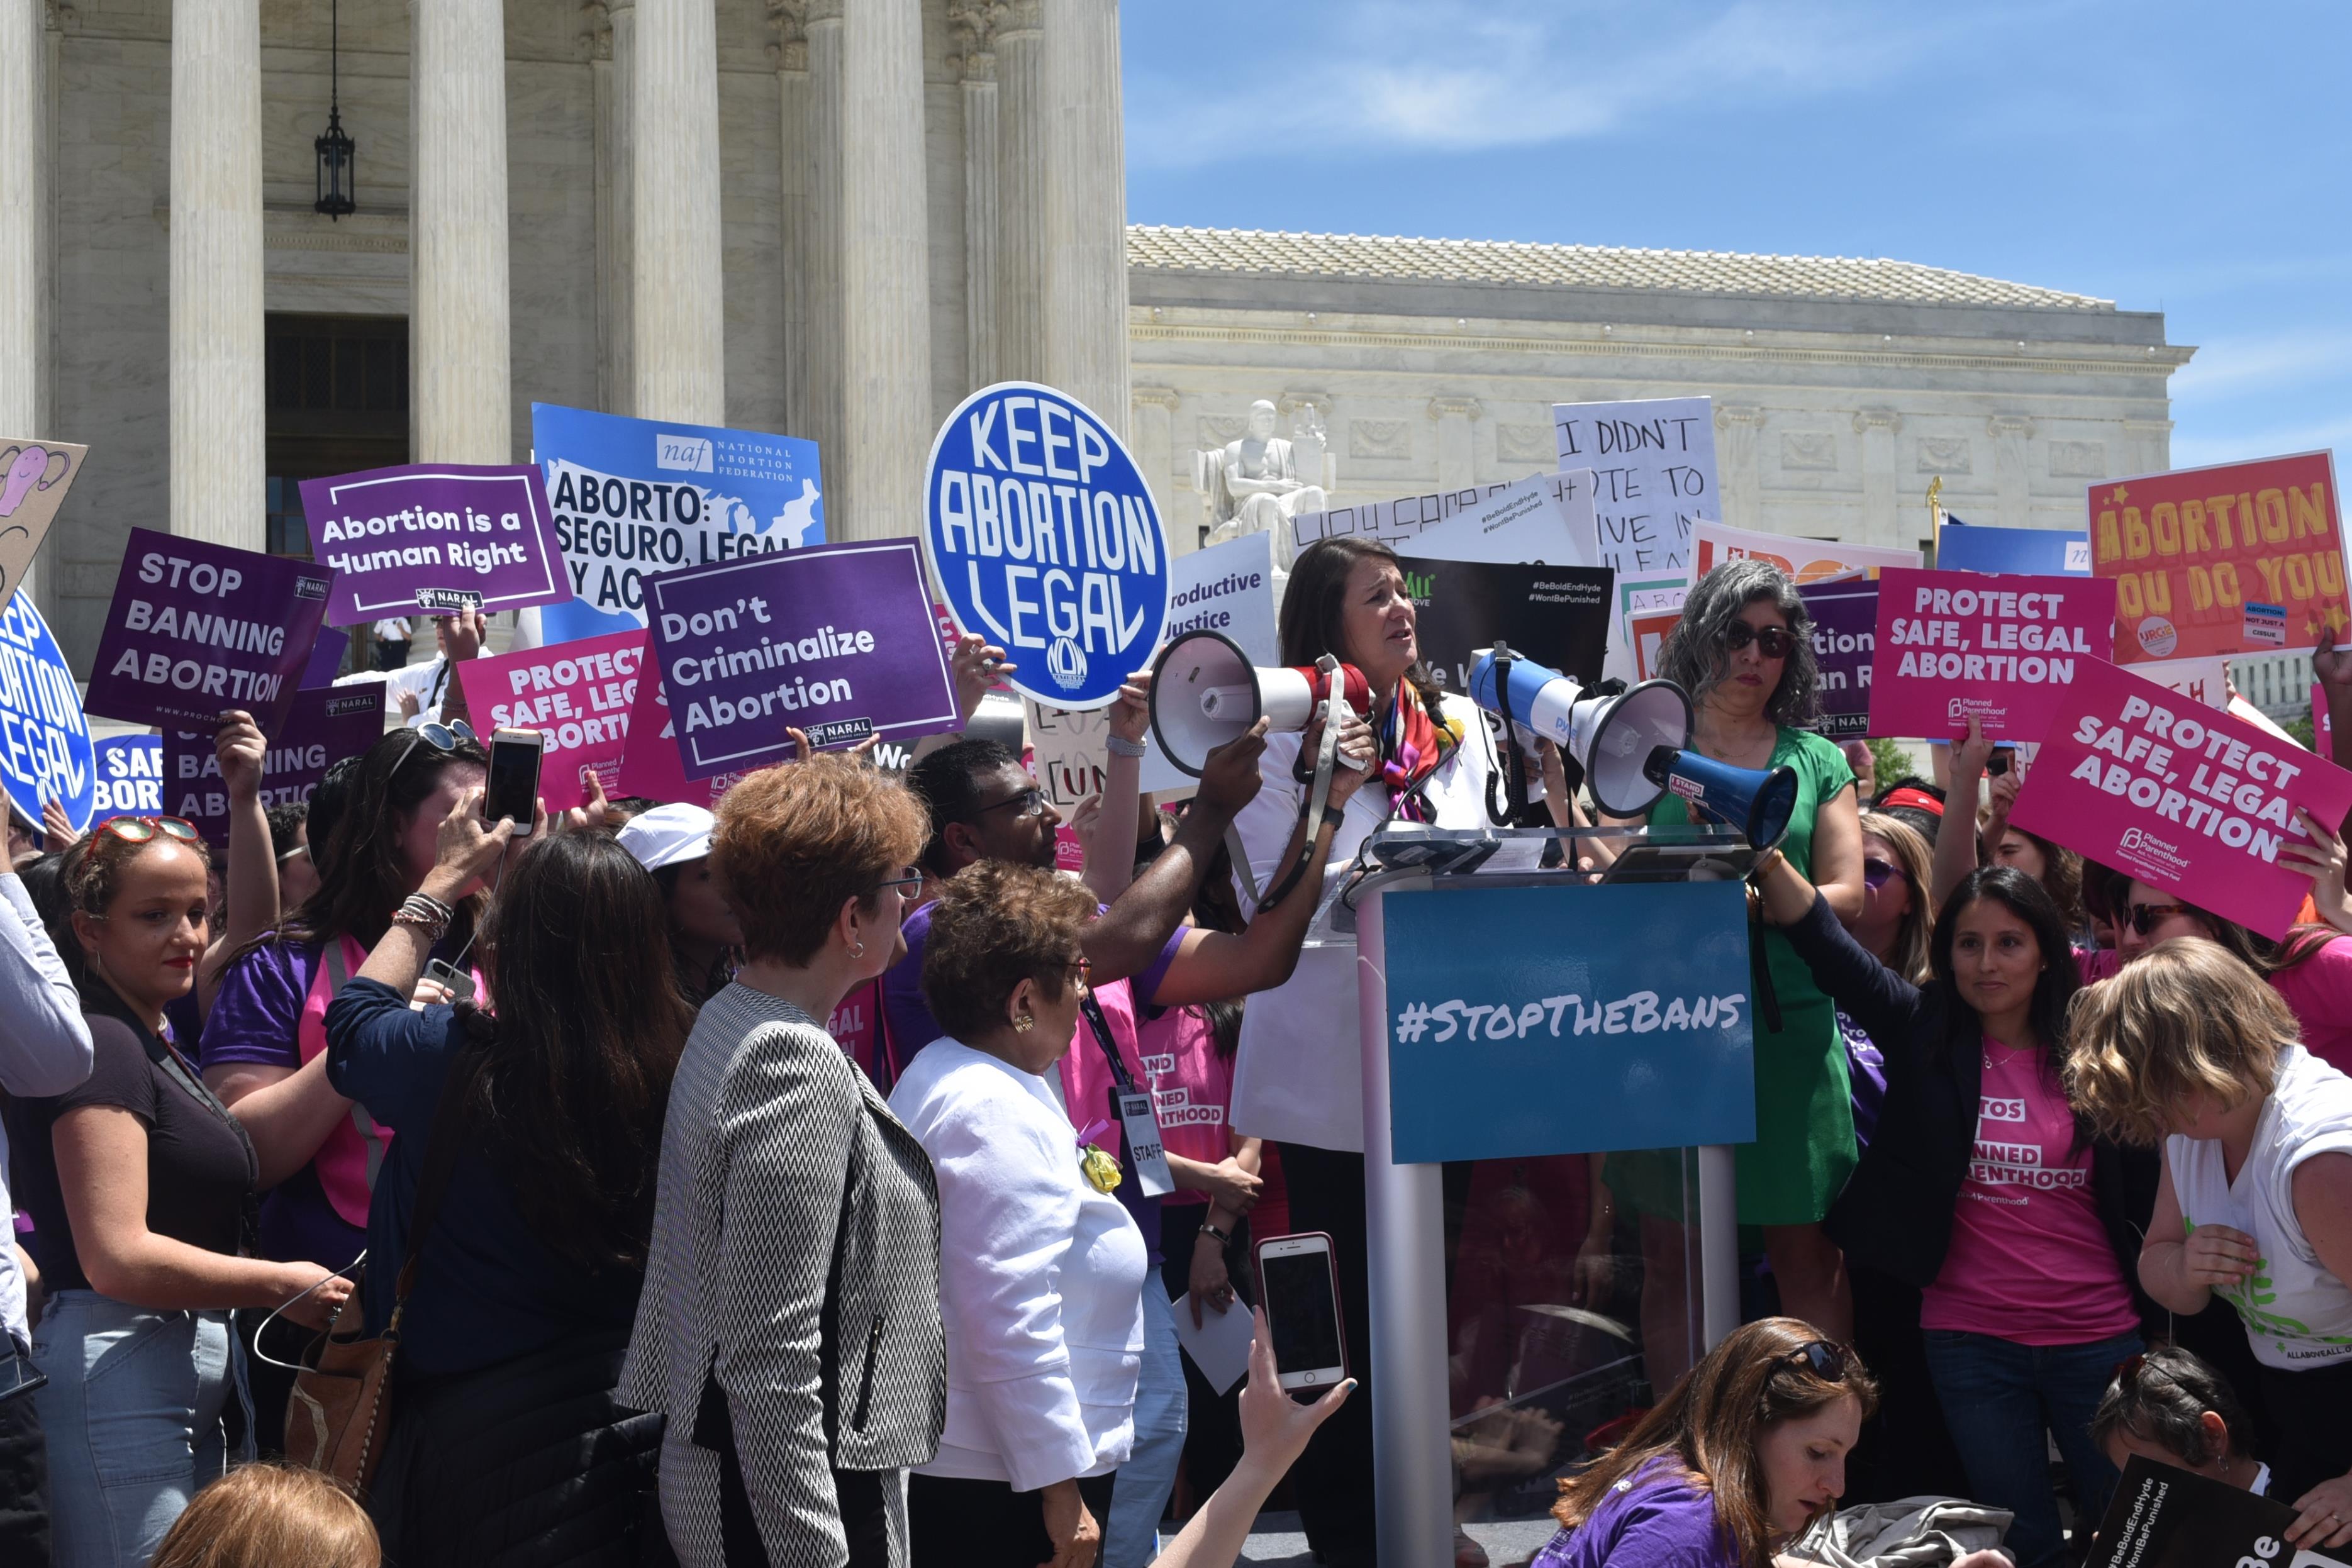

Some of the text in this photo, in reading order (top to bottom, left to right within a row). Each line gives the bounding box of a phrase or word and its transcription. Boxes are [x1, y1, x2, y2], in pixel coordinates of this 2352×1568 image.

[970, 397, 1109, 484] KEEP
[1556, 418, 1699, 457] I DIDN'T
[664, 439, 791, 472] naf NATIONAL
[718, 454, 793, 470] ABORTION
[718, 467, 793, 482] FEDERATION
[1661, 465, 1704, 498] TO
[554, 472, 711, 525] ABORTO:
[1481, 490, 1539, 524] #BeBoldEndHyde
[322, 506, 520, 543] Abortion is a
[940, 469, 1156, 575] ABORTION
[1483, 499, 1543, 534] #WontBePunished
[2097, 482, 2327, 564] ABORTION
[554, 514, 691, 567] SEGURO,
[327, 542, 527, 574] Human Right
[138, 553, 242, 598] STOP
[305, 582, 326, 593] NARAL
[570, 560, 595, 595] Y
[1171, 572, 1261, 609] roductive
[1532, 581, 1602, 592] #BeBoldEndHyde
[2115, 550, 2345, 617] OU DO YOU
[437, 592, 478, 604] NARAL
[968, 560, 1144, 655] LEGAL
[1529, 594, 1601, 604] #WontBePunished
[1915, 587, 2063, 620] PROTECT
[2246, 605, 2285, 617] ABORTION:
[125, 599, 284, 657] BANNING
[659, 595, 772, 643] Don't
[1164, 611, 1230, 640] Justice
[1890, 617, 2091, 653] SAFE, LEGAL
[2253, 630, 2276, 638] CISSUE
[508, 647, 644, 695] PROTECT
[672, 625, 876, 687] Criminalize
[1047, 637, 1088, 676] NOW
[1897, 652, 2074, 684] ABORTION
[111, 649, 282, 703] ABORTION
[342, 698, 373, 709] NARAL
[491, 692, 583, 730] SAFE,
[685, 677, 853, 733] Abortion
[1963, 698, 1992, 708] Planned
[1963, 706, 2005, 715] Parenthood
[827, 721, 868, 737] NARAL
[2120, 695, 2300, 789] PROTECT
[591, 759, 617, 770] Planned
[2073, 716, 2310, 837] SAFE, LEGAL
[1672, 786, 1692, 798] WITH
[1676, 779, 1701, 794] STAND
[2070, 755, 2283, 864] ABORTION
[2139, 841, 2188, 868] Parenthood
[2143, 833, 2178, 853] Planned
[1134, 1143, 1162, 1162] STAFF
